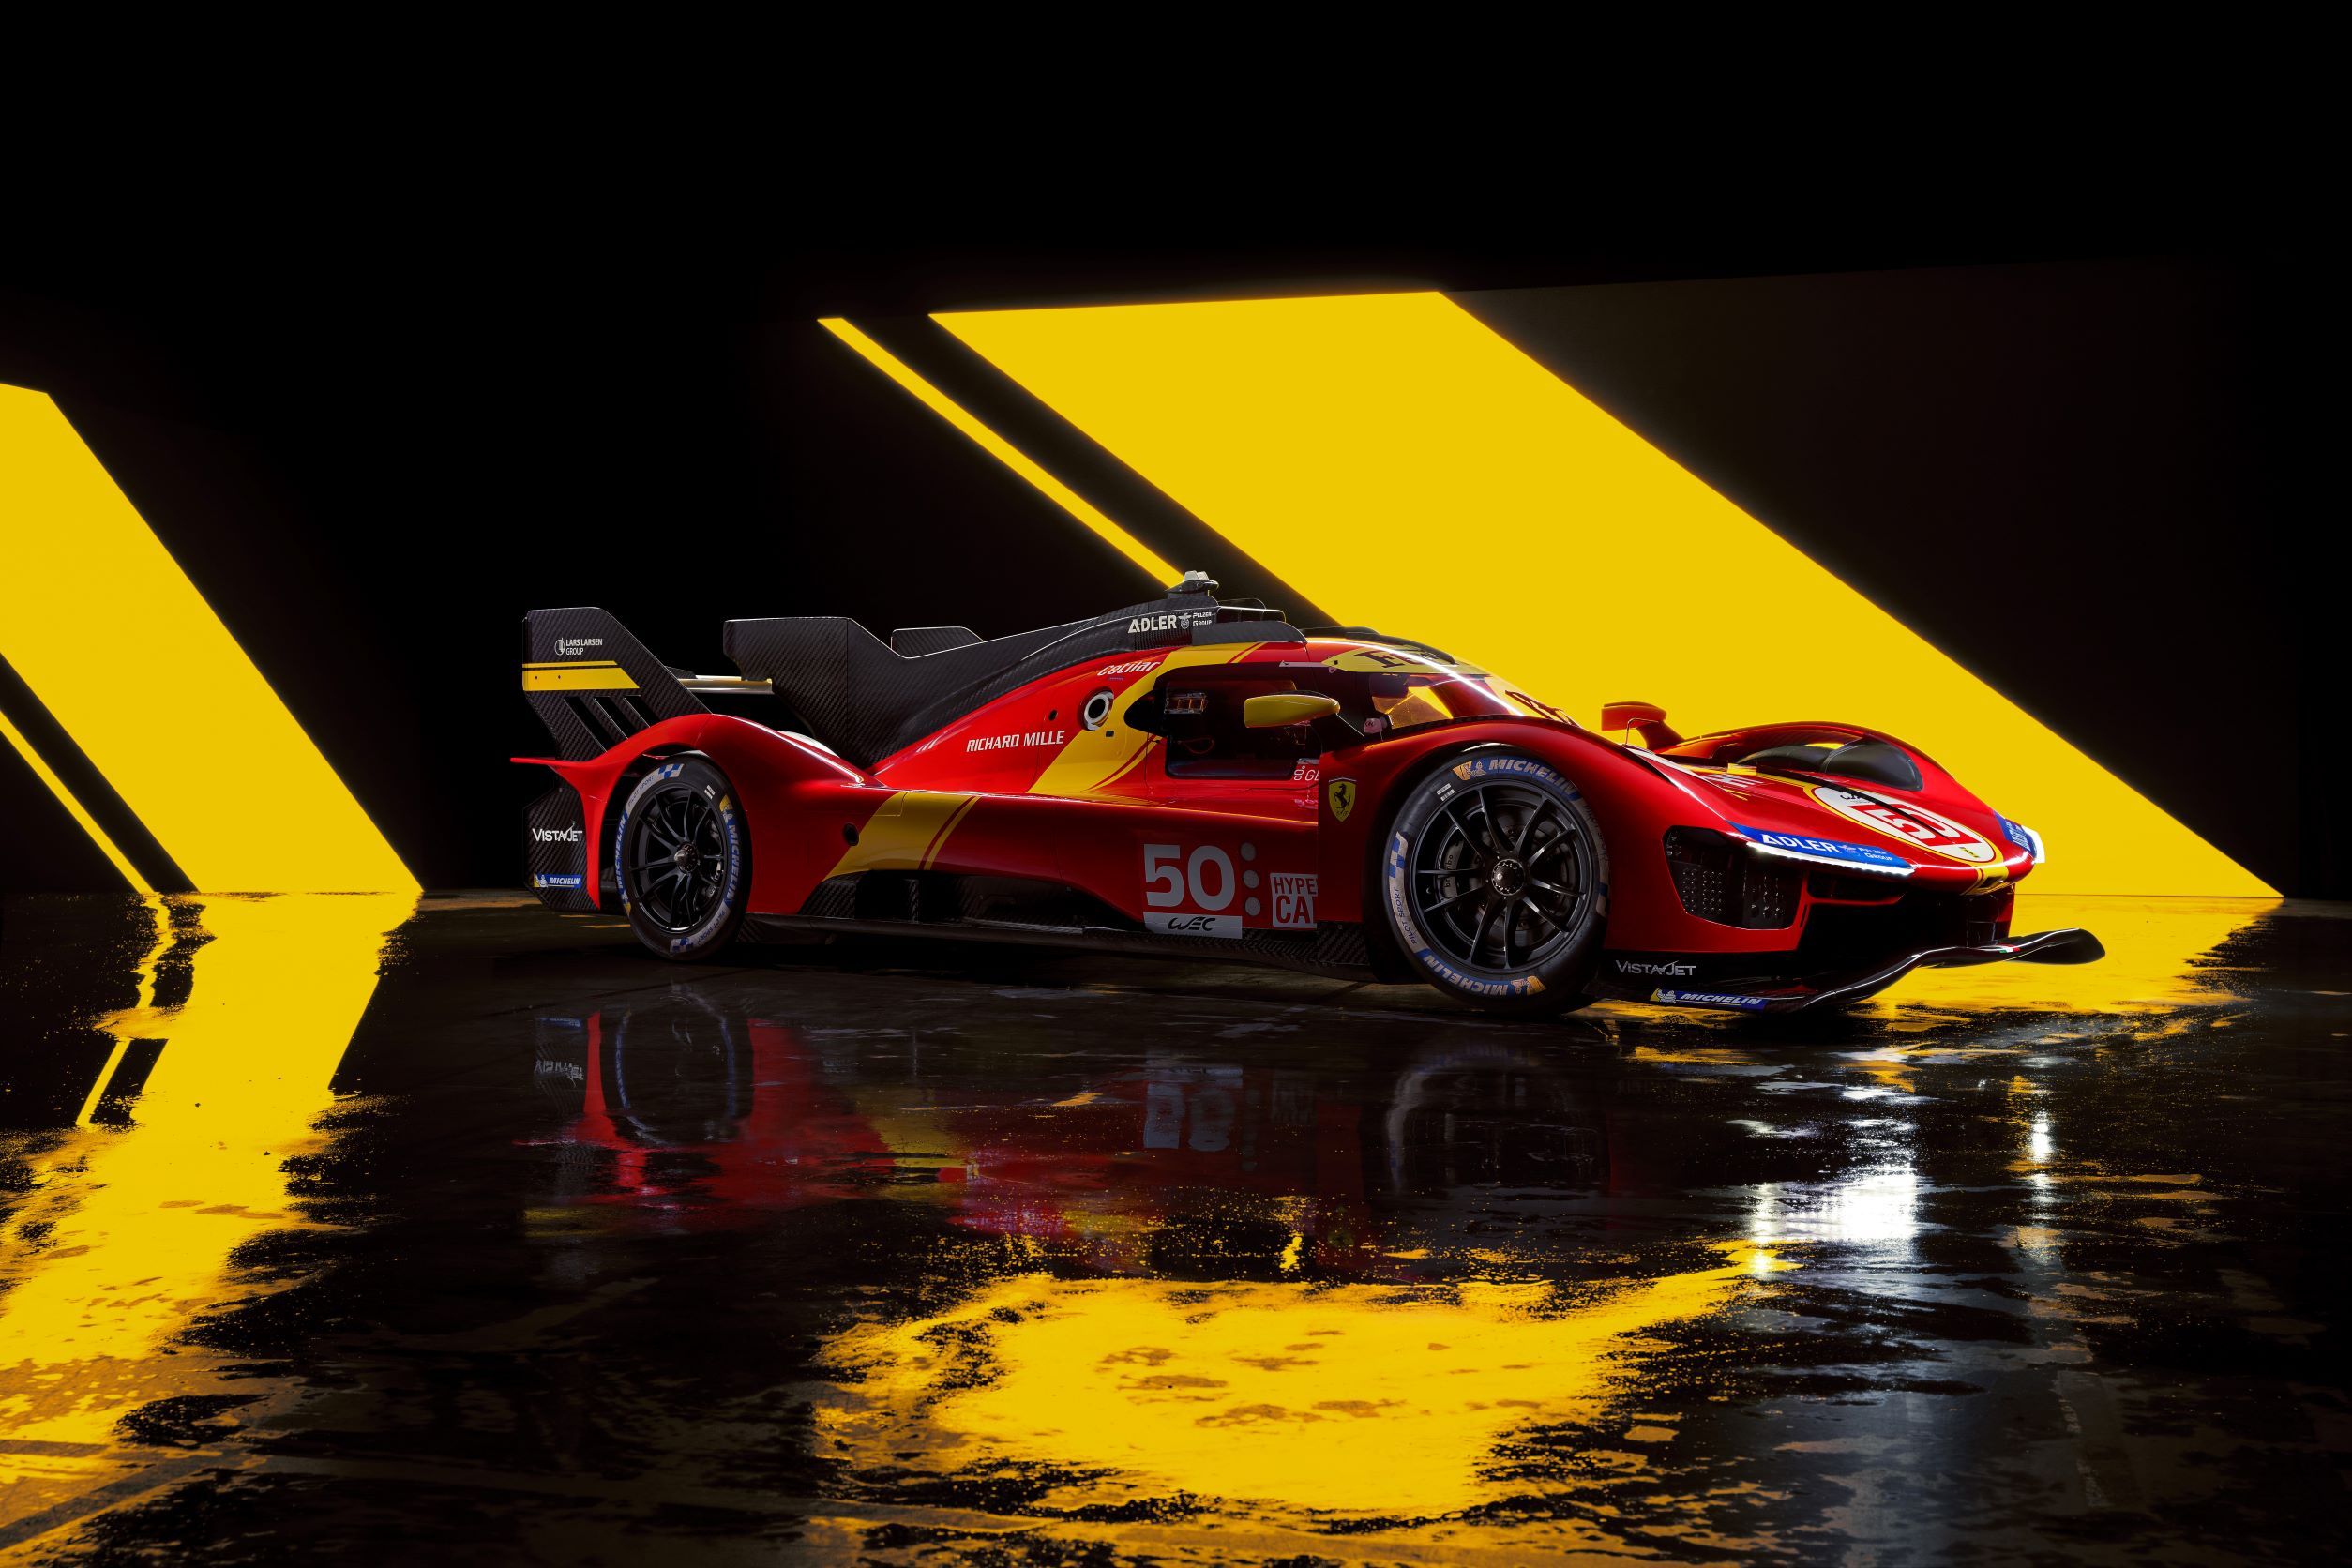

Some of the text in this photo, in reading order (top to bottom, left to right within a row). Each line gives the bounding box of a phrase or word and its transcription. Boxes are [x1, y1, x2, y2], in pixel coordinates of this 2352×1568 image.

[1128, 615, 1177, 634] ADLER
[565, 638, 603, 647] LARS LARSEN
[565, 647, 584, 656] GROUP
[966, 731, 1065, 752] RICHARD MILLE
[1488, 759, 1578, 795] MICHELIN
[532, 825, 583, 842] VISTAJET
[1761, 834, 1842, 853] ADLER
[725, 824, 741, 900] MICHELIN
[1863, 852, 1893, 861] GROUP
[1143, 844, 1236, 911] 50
[1444, 854, 1454, 888] brmbo
[549, 877, 580, 885] MICHELIN
[1273, 877, 1319, 895] HYPE
[1275, 895, 1317, 924] CA
[1394, 889, 1418, 944] PILOT SPORT
[1168, 916, 1216, 931] WEC
[1423, 955, 1509, 996] MICHELIN
[1615, 960, 1697, 976] VISTAJET
[1680, 992, 1763, 1005] MICHELIN
